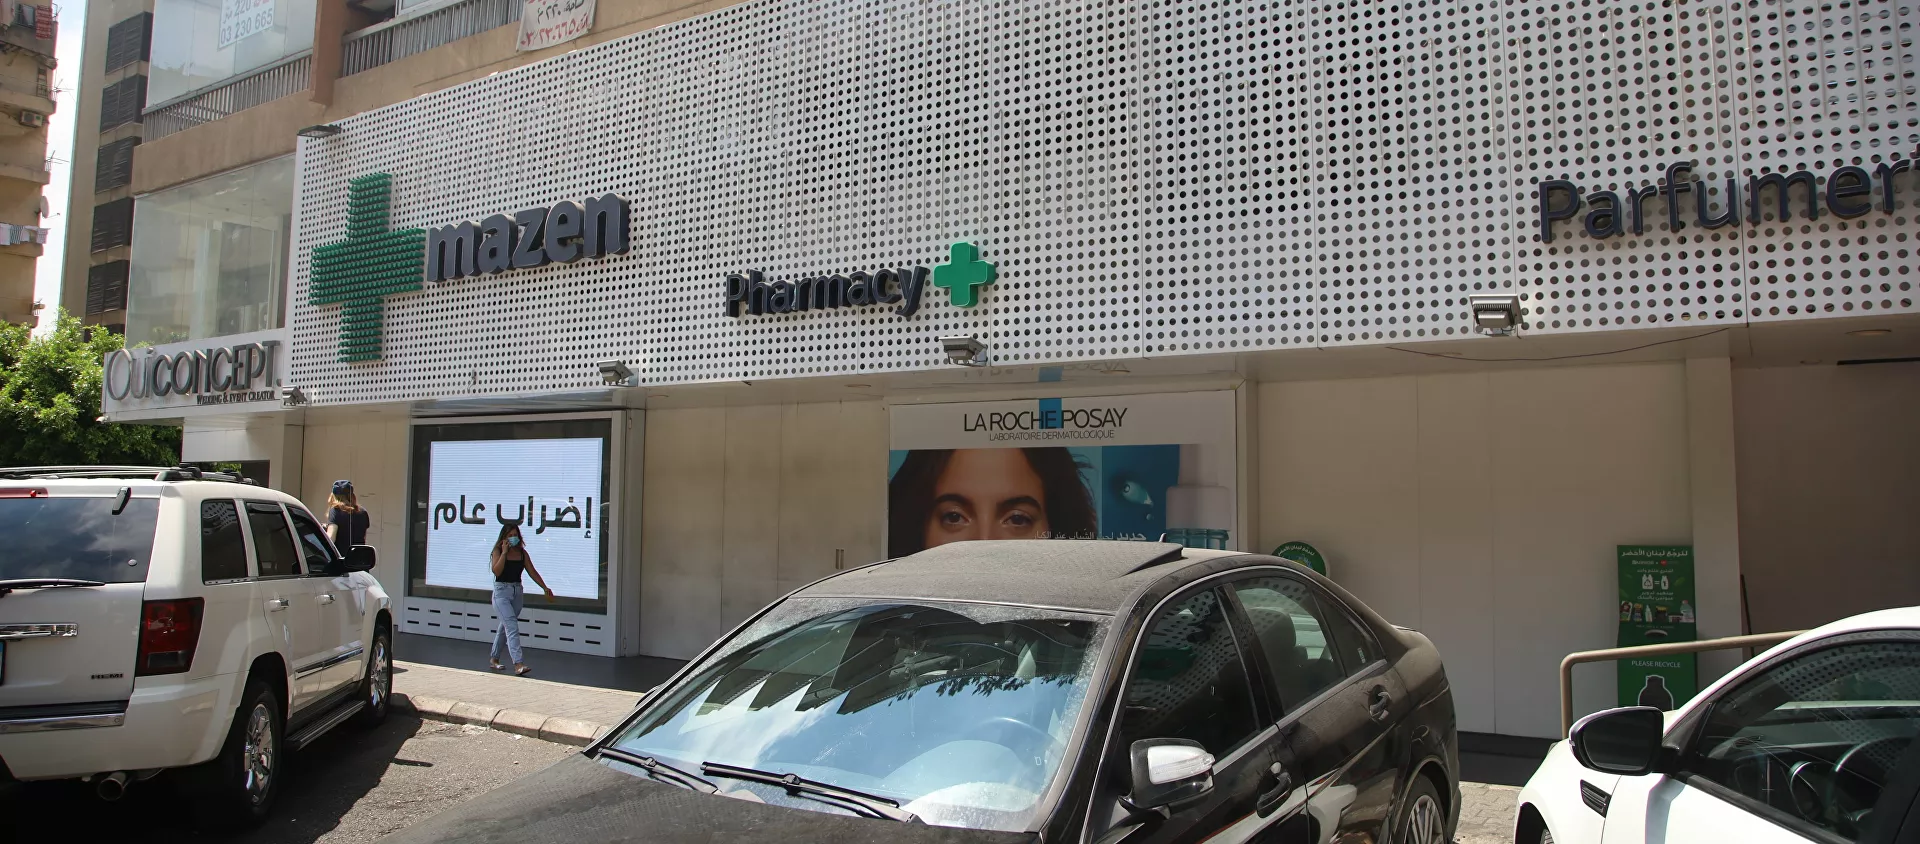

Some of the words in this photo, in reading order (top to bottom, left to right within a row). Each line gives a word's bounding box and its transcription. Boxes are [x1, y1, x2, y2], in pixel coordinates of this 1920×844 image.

[221, 26, 232, 44] 03
[235, 17, 252, 39] 230
[254, 8, 273, 30] 665
[427, 192, 630, 283] mazen
[726, 265, 930, 318] Pharmacy
[223, 392, 229, 404] &
[249, 391, 276, 401] CREATOR
[964, 413, 987, 431] LA
[990, 411, 1057, 431] ROCHE
[1061, 407, 1128, 428] POSAY
[989, 432, 1041, 441] LABORATOIRE
[1042, 429, 1114, 440] DERMATOLOGIQUE
[434, 494, 486, 530] عام
[496, 495, 592, 538] إضراب
